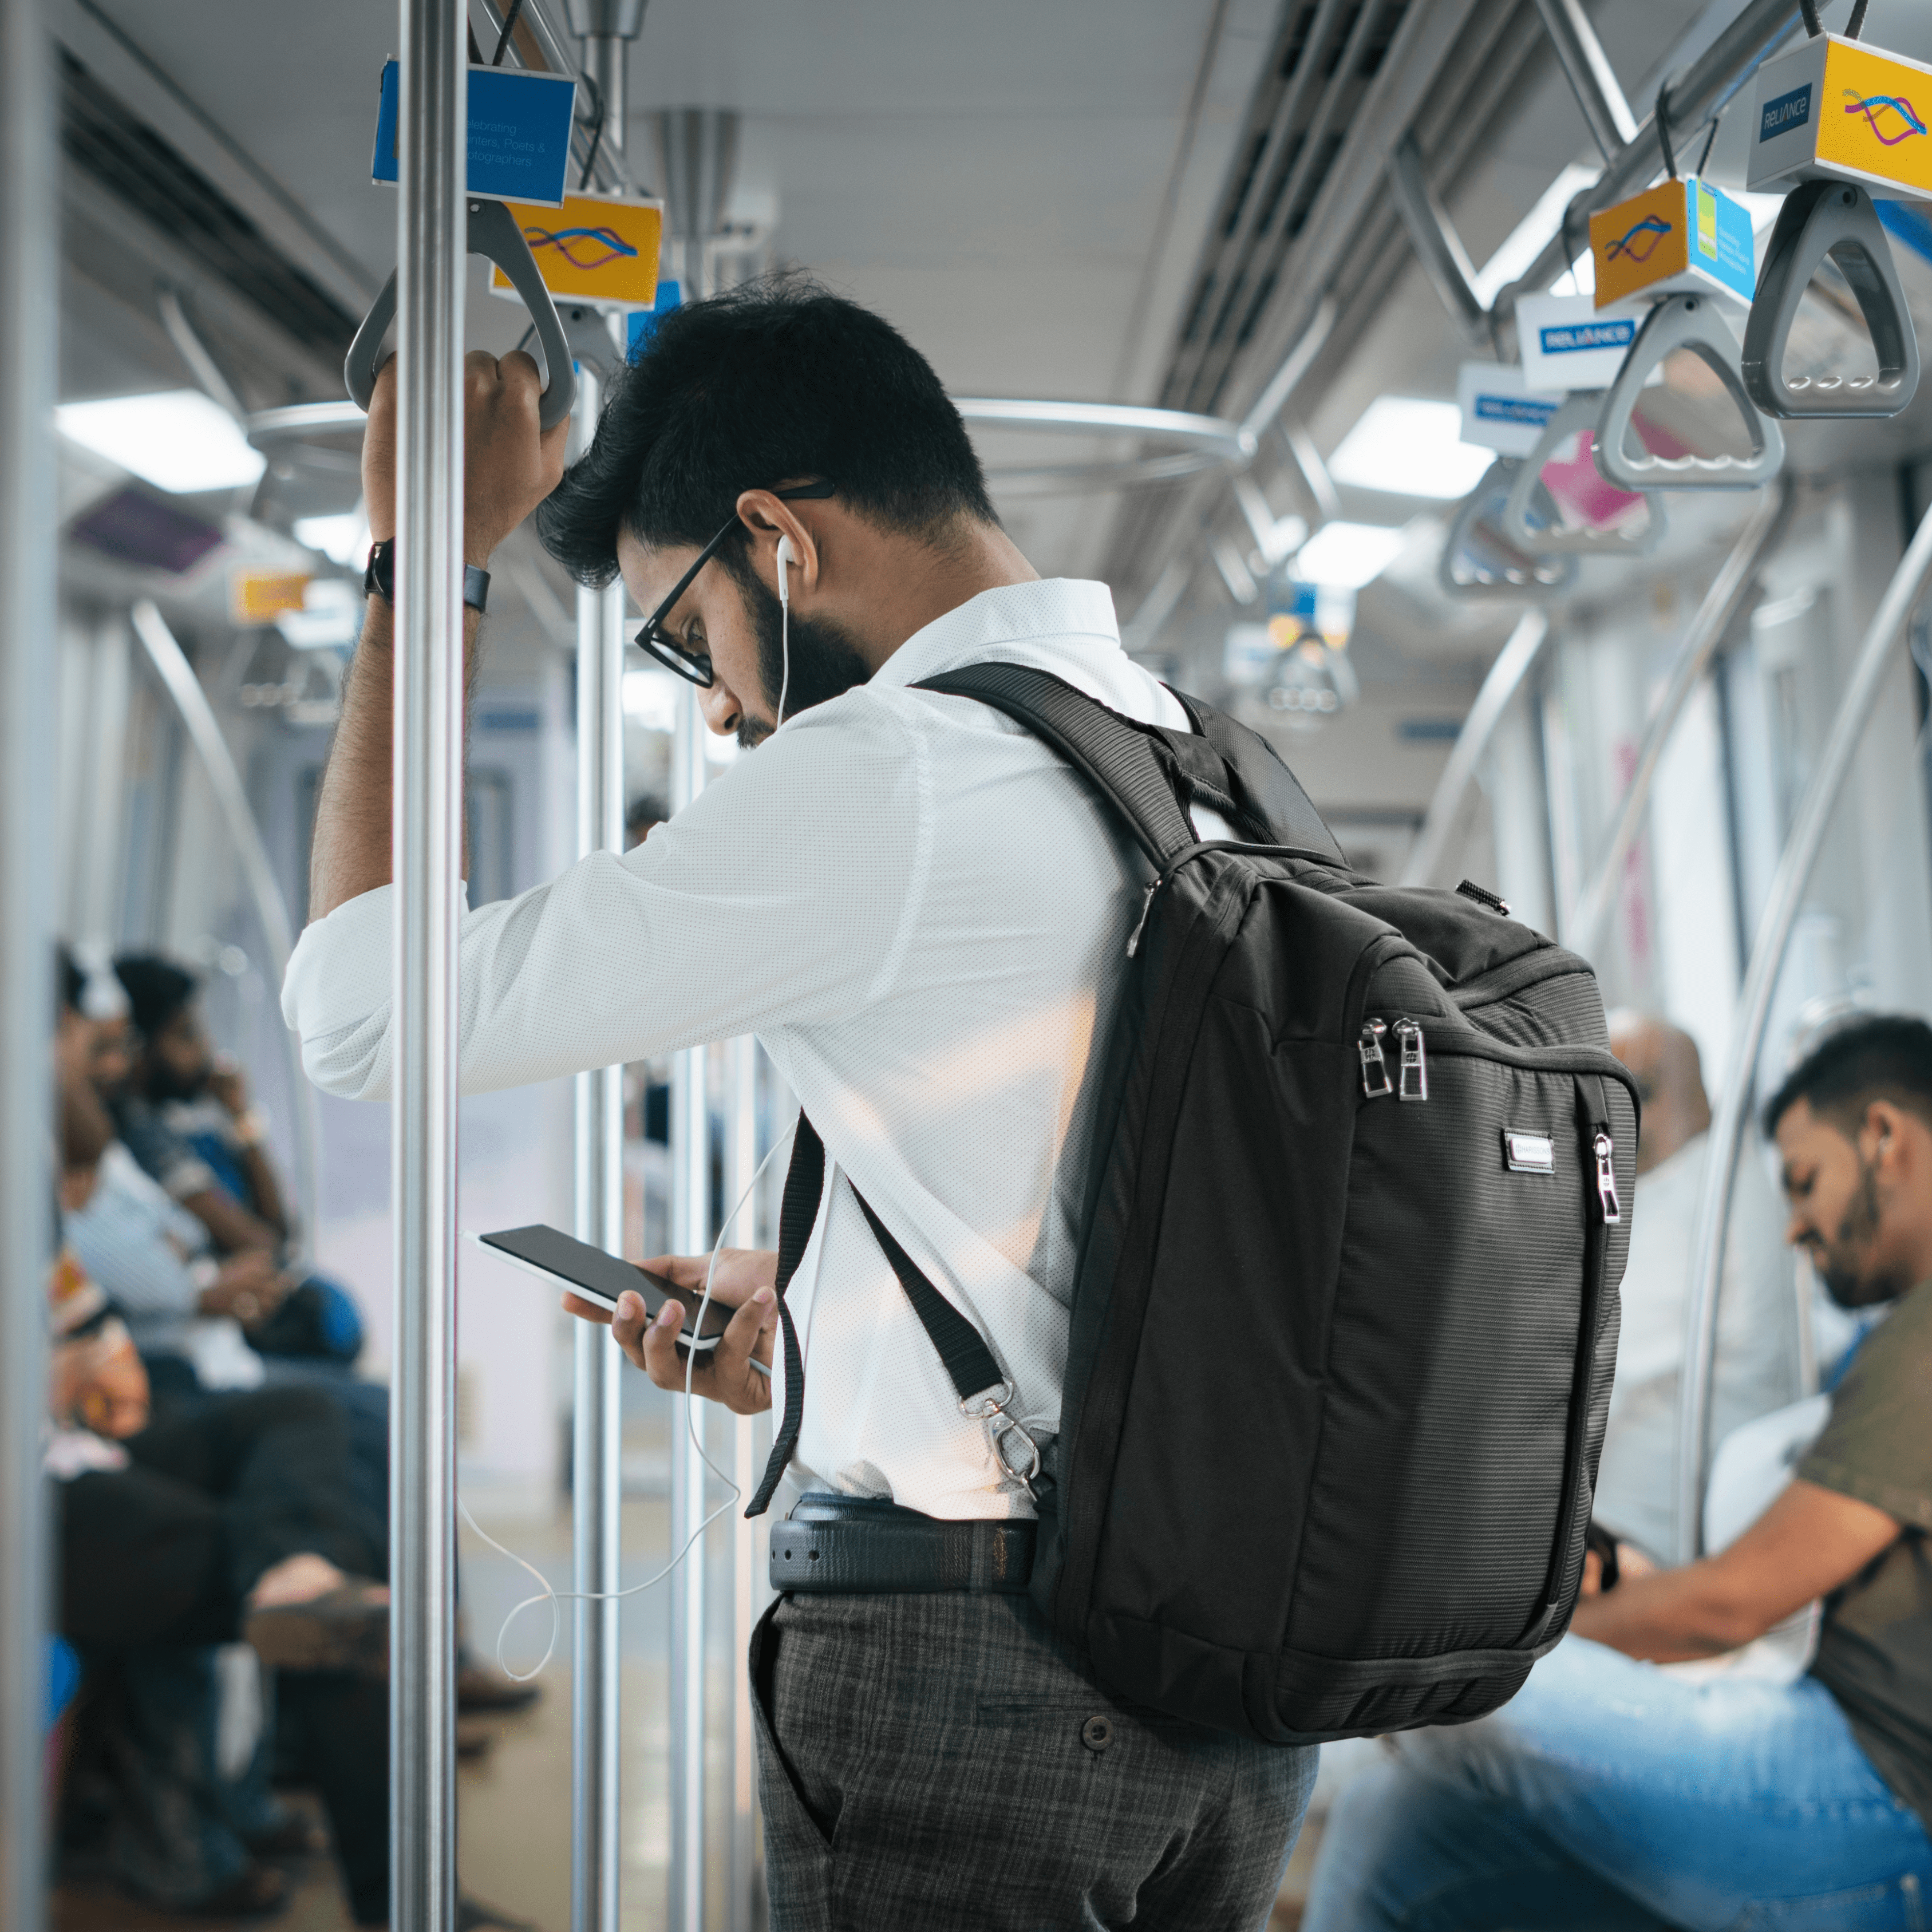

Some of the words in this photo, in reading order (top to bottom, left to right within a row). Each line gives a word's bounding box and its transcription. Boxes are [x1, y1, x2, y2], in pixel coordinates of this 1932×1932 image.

[468, 119, 516, 136] elebrating
[468, 134, 500, 149] inters,
[504, 139, 535, 152] Poets
[538, 143, 546, 153] &
[468, 151, 532, 167] otographers
